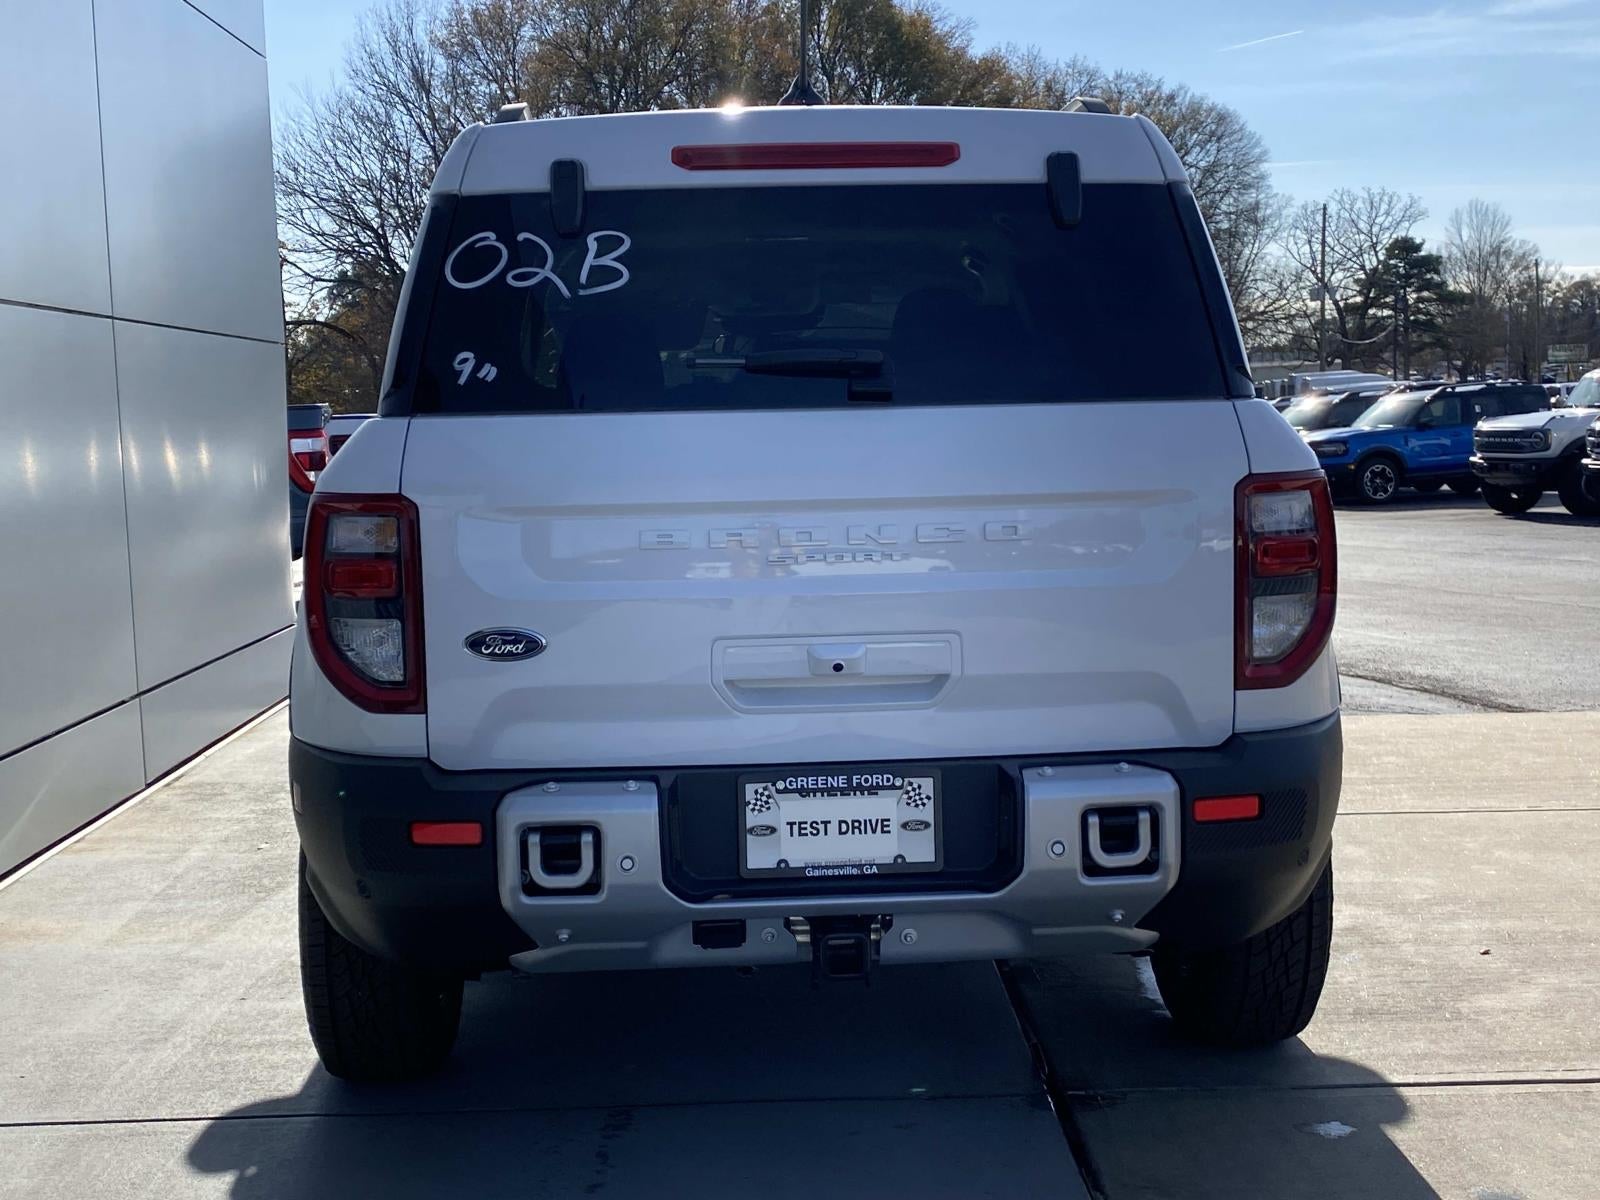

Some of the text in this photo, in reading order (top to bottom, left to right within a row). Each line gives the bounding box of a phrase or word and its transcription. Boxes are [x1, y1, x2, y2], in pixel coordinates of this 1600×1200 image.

[639, 520, 1033, 550] BRONCO
[767, 551, 909, 565] SPORT
[481, 635, 526, 654] Ford
[785, 774, 894, 789] GREENE FORD
[786, 818, 891, 837] TEST DRIVE
[863, 865, 879, 874] GA
